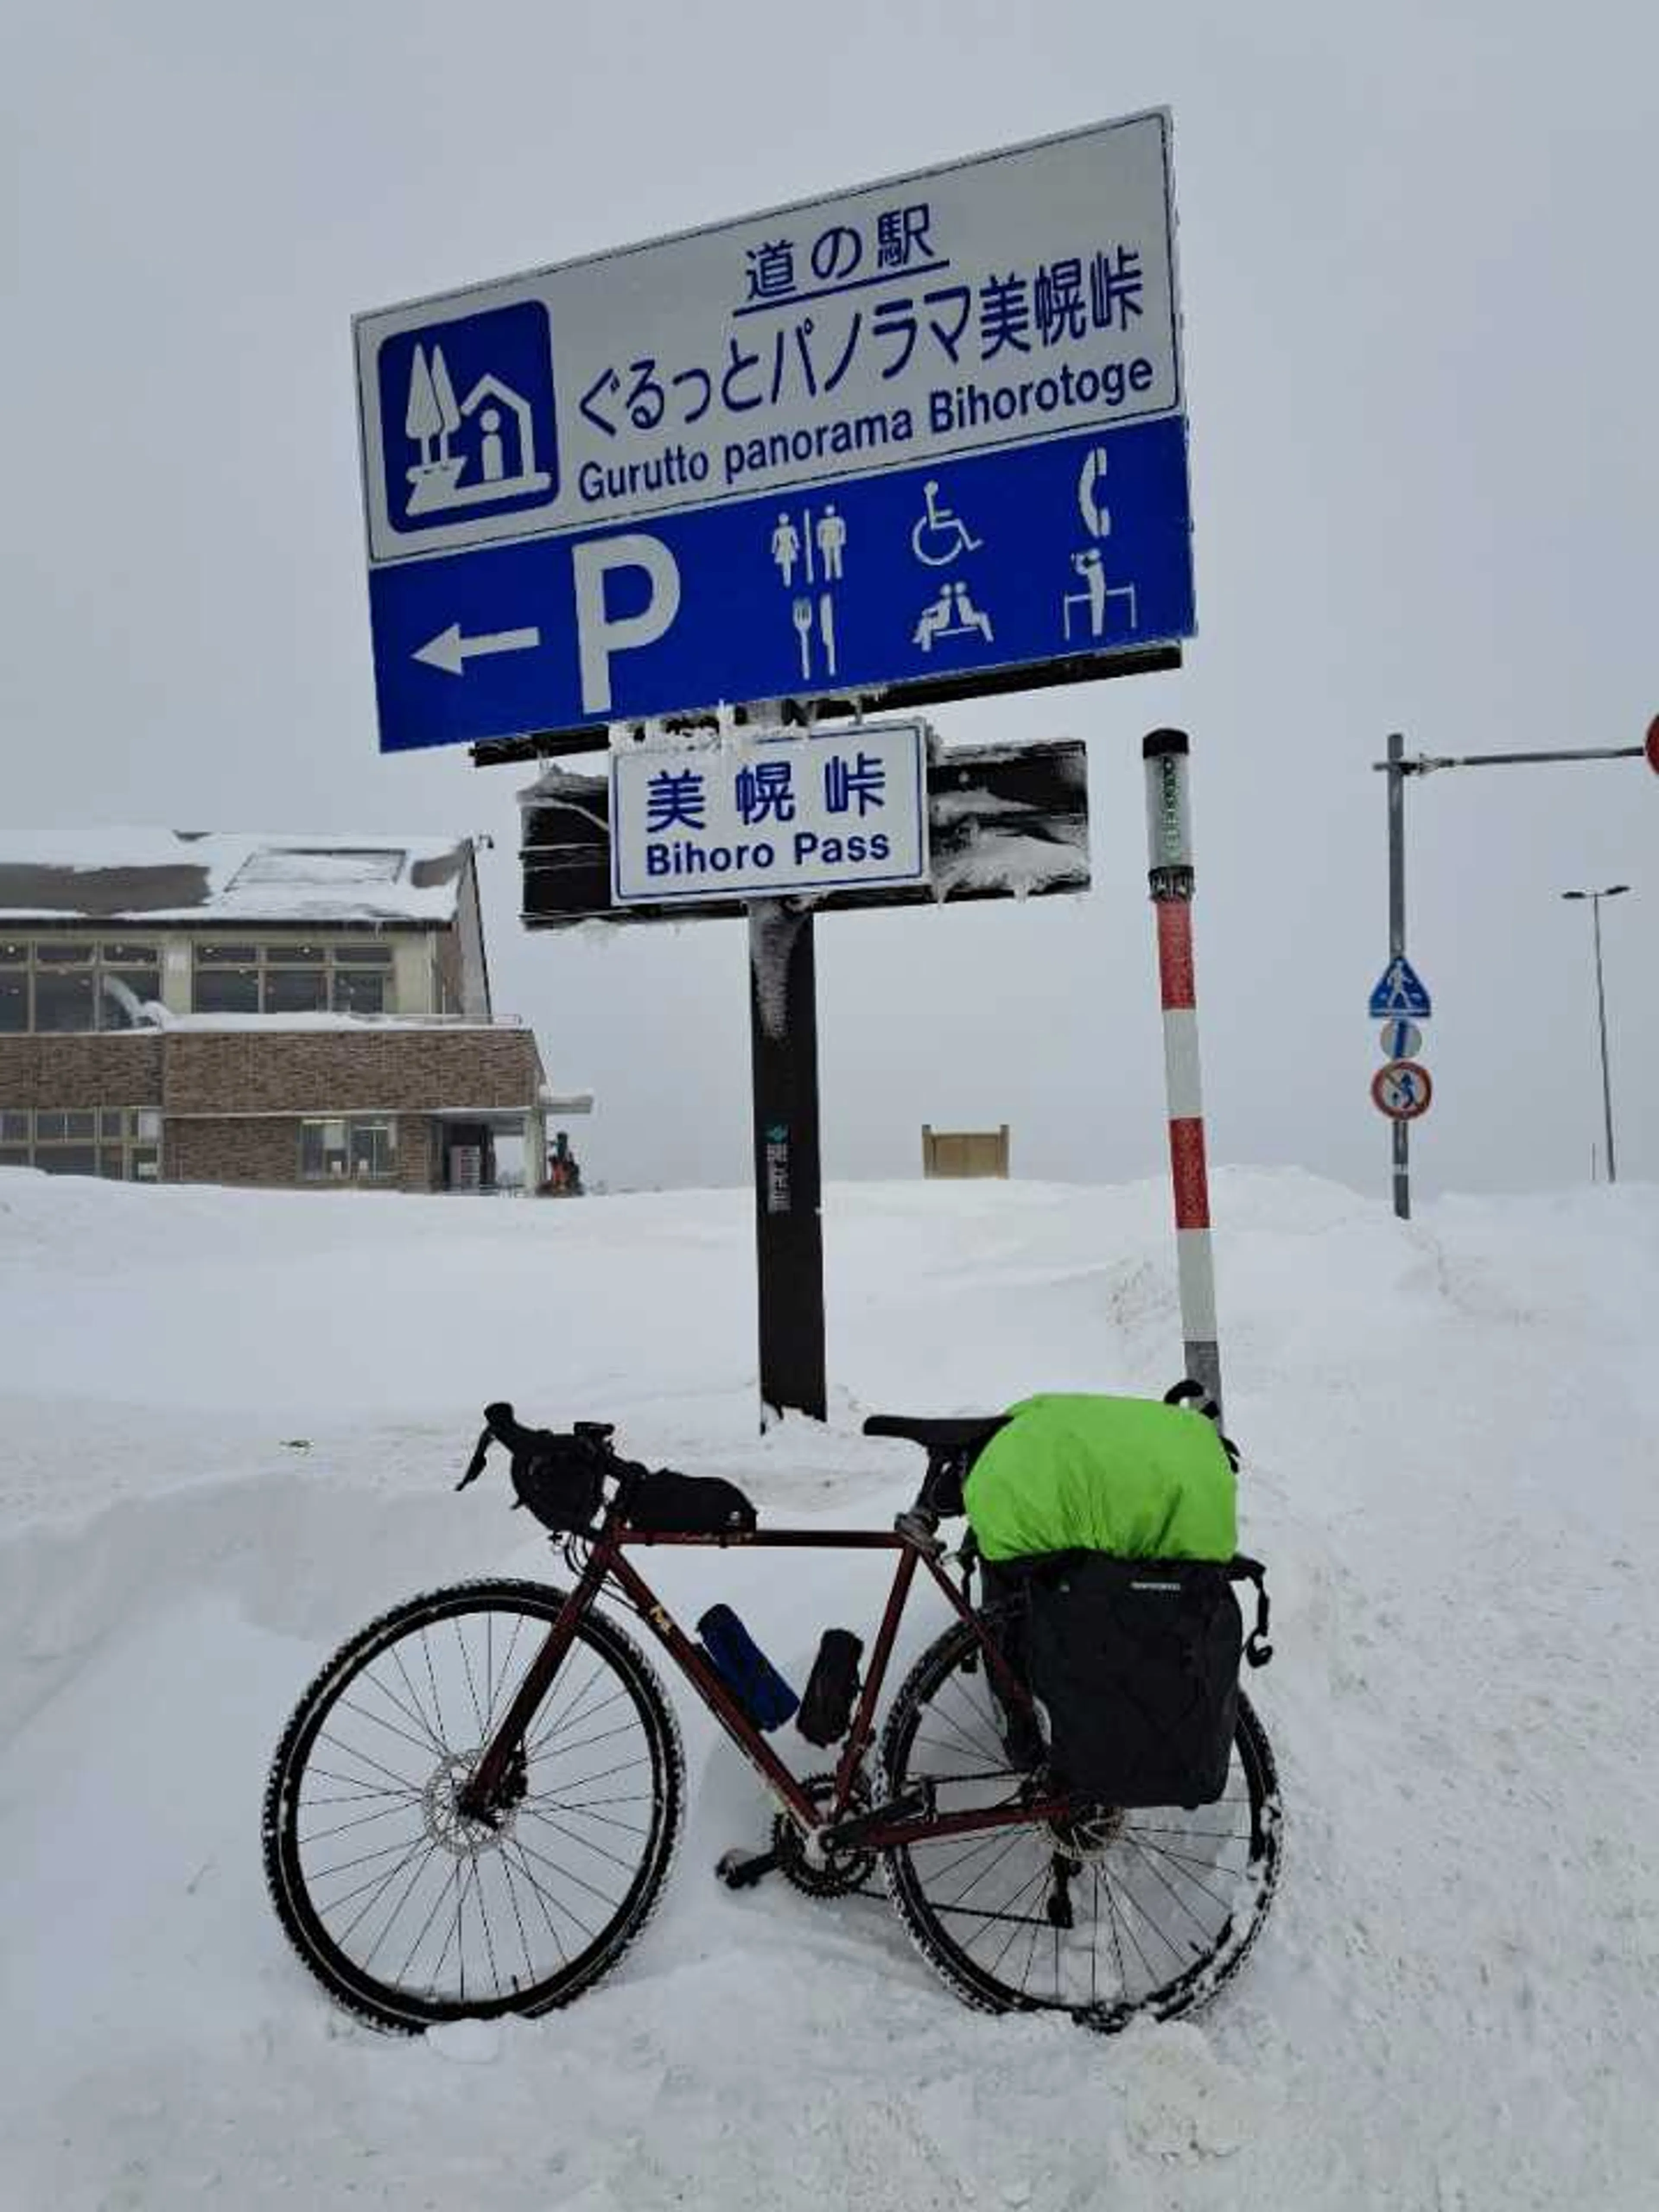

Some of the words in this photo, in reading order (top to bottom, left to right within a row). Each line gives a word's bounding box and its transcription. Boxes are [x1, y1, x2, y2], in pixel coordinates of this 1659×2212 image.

[745, 203, 934, 300] 道の駅
[579, 244, 1144, 436] ぐるっとパノラマ美幌峠
[579, 444, 709, 502] Gurutto
[725, 404, 913, 483] panorama
[930, 357, 1153, 435] Bihorotoge
[572, 534, 681, 715] P
[646, 751, 886, 833] 美幌峠
[647, 842, 774, 876] Bihoro
[794, 832, 890, 865] Pass
